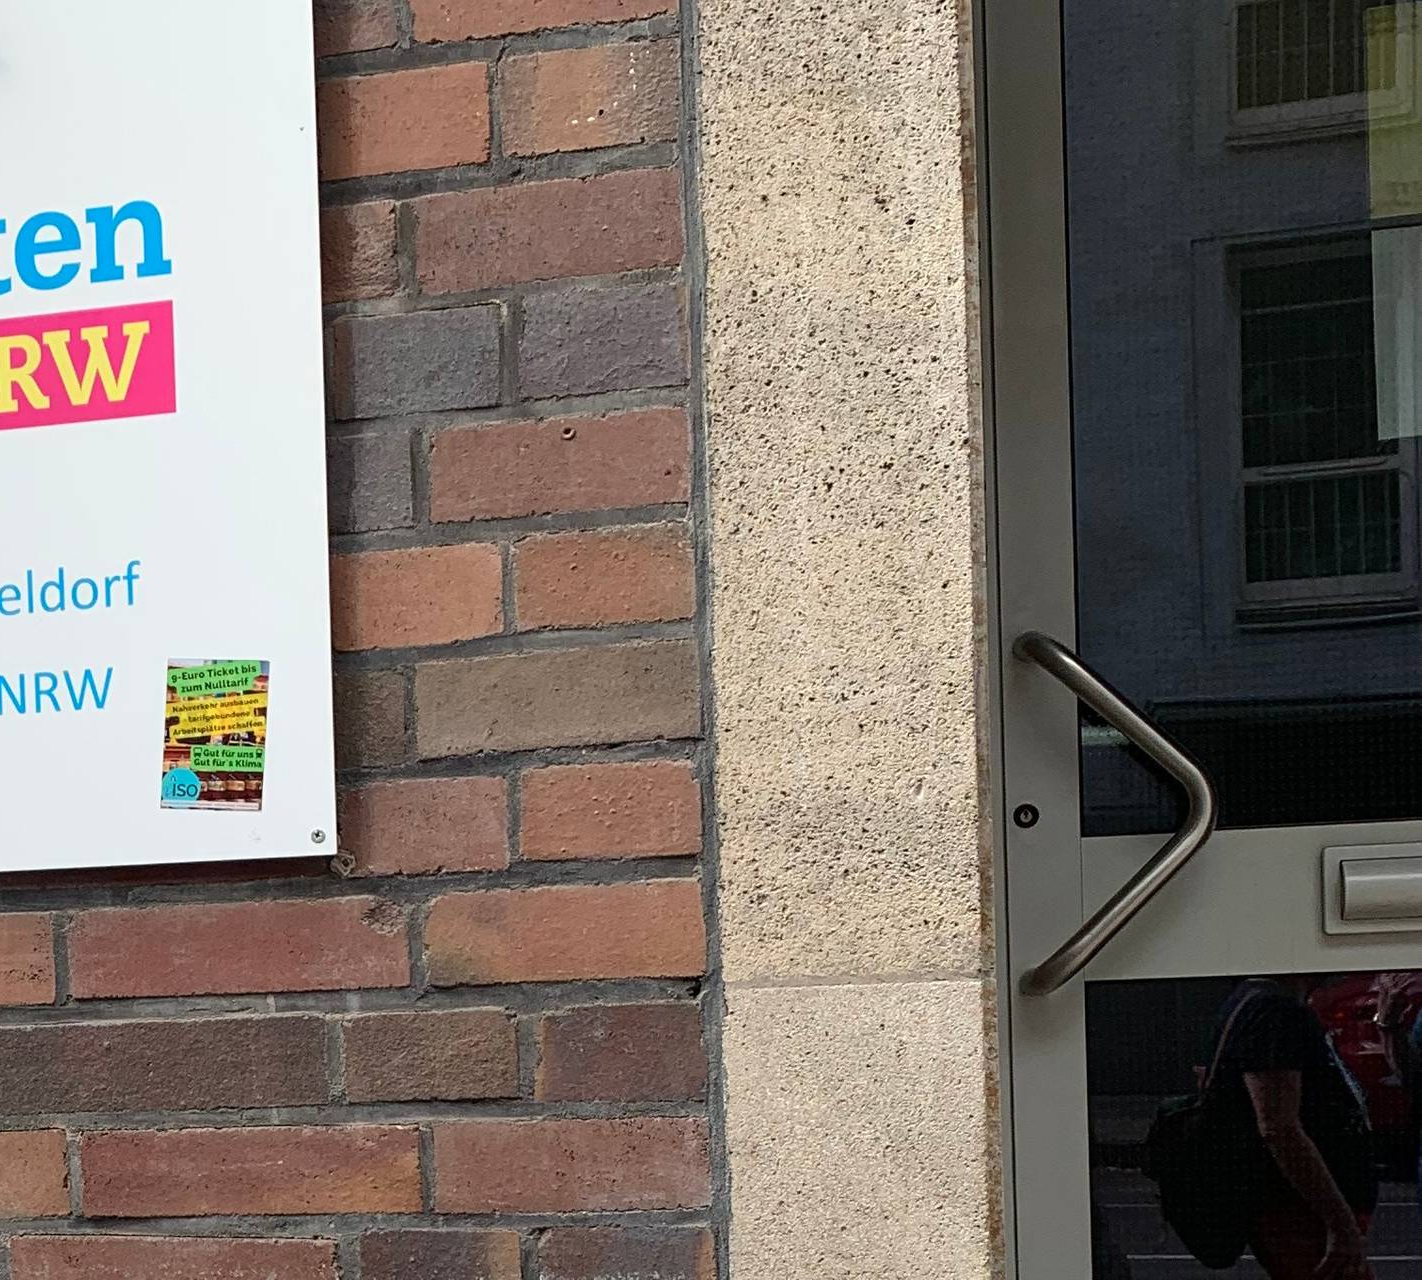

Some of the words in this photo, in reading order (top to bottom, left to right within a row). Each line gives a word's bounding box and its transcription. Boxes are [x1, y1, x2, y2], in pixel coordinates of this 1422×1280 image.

[171, 671, 205, 684] 9-Euro
[207, 666, 239, 678] Ticket
[241, 664, 257, 674] bis
[180, 684, 203, 693] zum
[204, 677, 249, 690] Nulltarif
[203, 749, 220, 757] Gut
[221, 749, 235, 757] für
[194, 758, 210, 767] Gut
[235, 759, 262, 768] Klima
[172, 784, 198, 797] ISO
